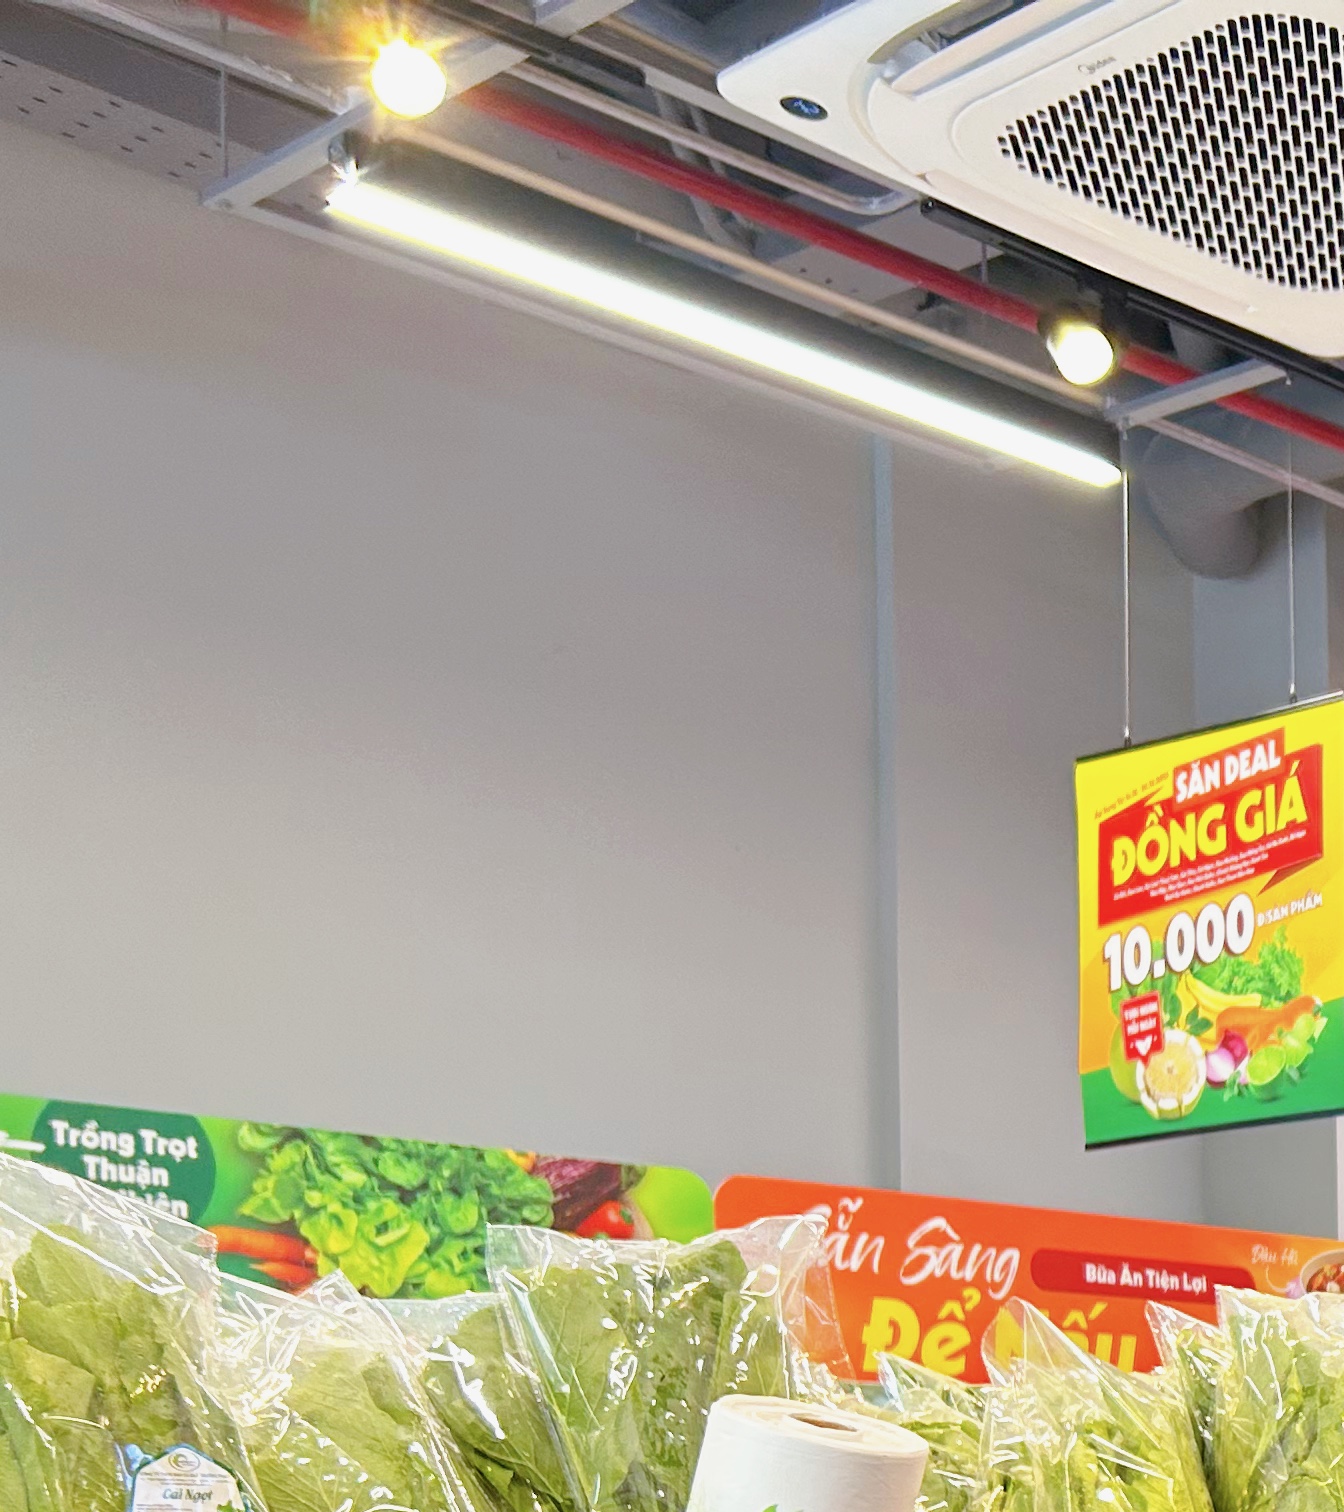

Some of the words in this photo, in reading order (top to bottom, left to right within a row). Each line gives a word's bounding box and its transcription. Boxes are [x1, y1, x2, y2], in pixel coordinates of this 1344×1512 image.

[1176, 759, 1220, 803] SĂN
[1224, 740, 1281, 786] DEAL
[1111, 802, 1228, 887] ĐỒNG
[1235, 760, 1307, 843] GIÁ
[1103, 893, 1256, 993] 10.000
[49, 1119, 136, 1158] Trồng
[139, 1128, 198, 1163] Trọt
[81, 1154, 170, 1190] Thuận
[901, 1216, 1021, 1299] Sàng
[1085, 1261, 1117, 1285] Bữa
[1119, 1259, 1144, 1287] Ăn
[1145, 1269, 1179, 1292] Tiện
[1182, 1272, 1207, 1294] Lợi
[862, 1287, 981, 1374] Để
